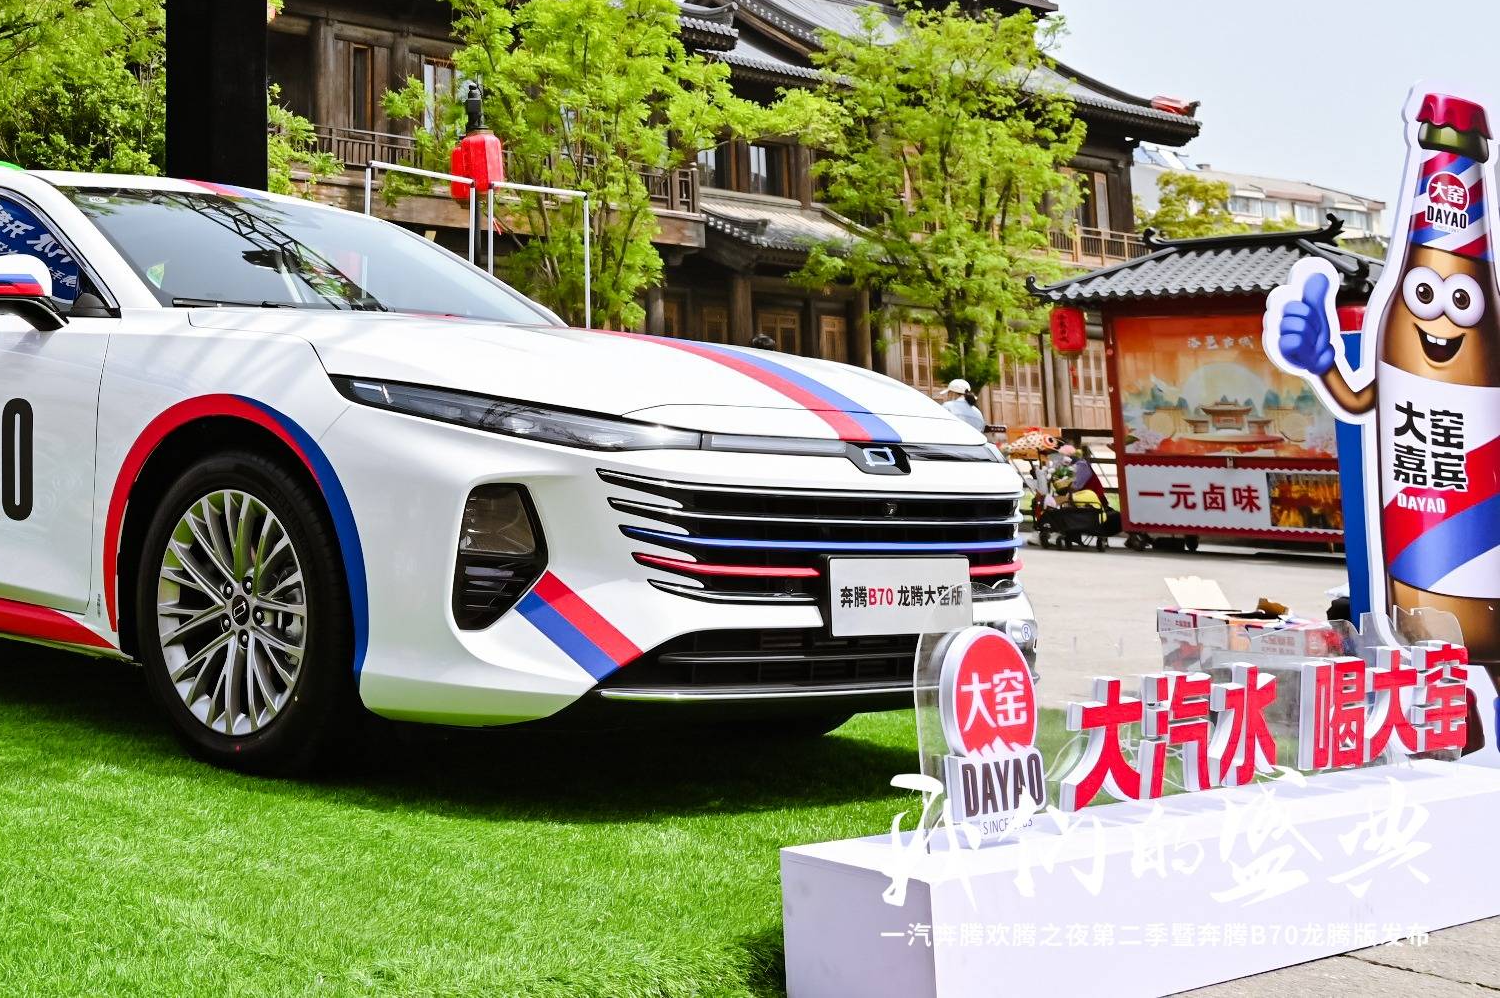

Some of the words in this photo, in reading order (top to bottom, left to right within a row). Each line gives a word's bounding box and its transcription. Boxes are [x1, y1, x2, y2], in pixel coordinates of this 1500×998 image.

[1431, 181, 1465, 204] 大窑
[1427, 205, 1467, 229] DAYAO
[1393, 401, 1464, 449] 大窑
[1393, 442, 1466, 489] 嘉宾
[1139, 483, 1261, 513] 一元卤味
[1397, 493, 1446, 513] DAYAO
[840, 586, 893, 608] 奔腾B70
[961, 669, 1027, 732] 大窑
[1300, 642, 1468, 770] 喝大窑
[1064, 662, 1278, 811] 大汽水
[962, 753, 1044, 817] DAYAO
